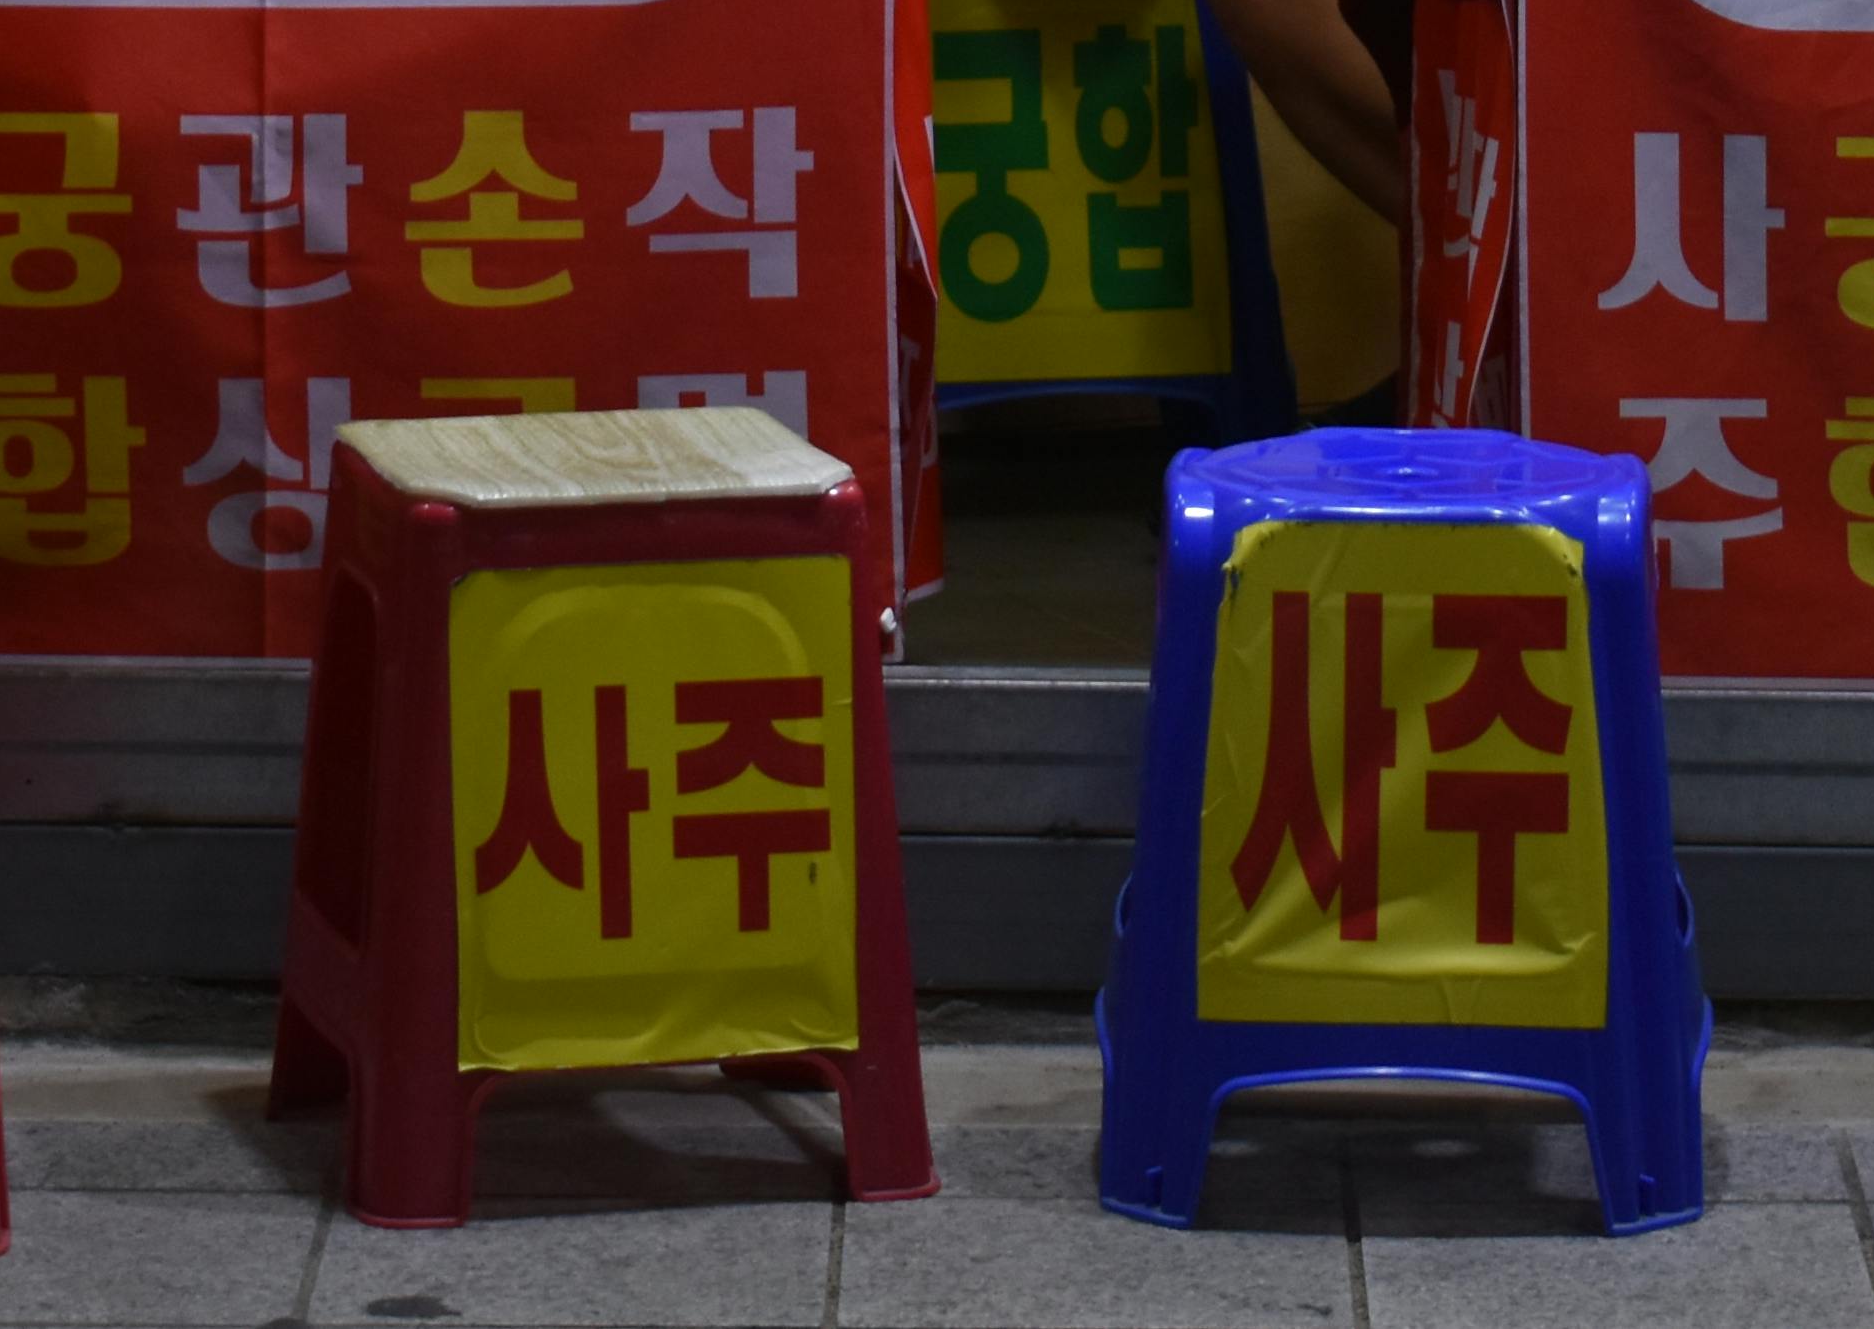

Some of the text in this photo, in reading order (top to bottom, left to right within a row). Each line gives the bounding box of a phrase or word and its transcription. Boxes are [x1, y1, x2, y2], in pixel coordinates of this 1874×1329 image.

[931, 23, 1199, 322] 궁합
[1597, 131, 1785, 591] 사주
[474, 676, 831, 940] 사주
[1230, 590, 1574, 946] 사주
